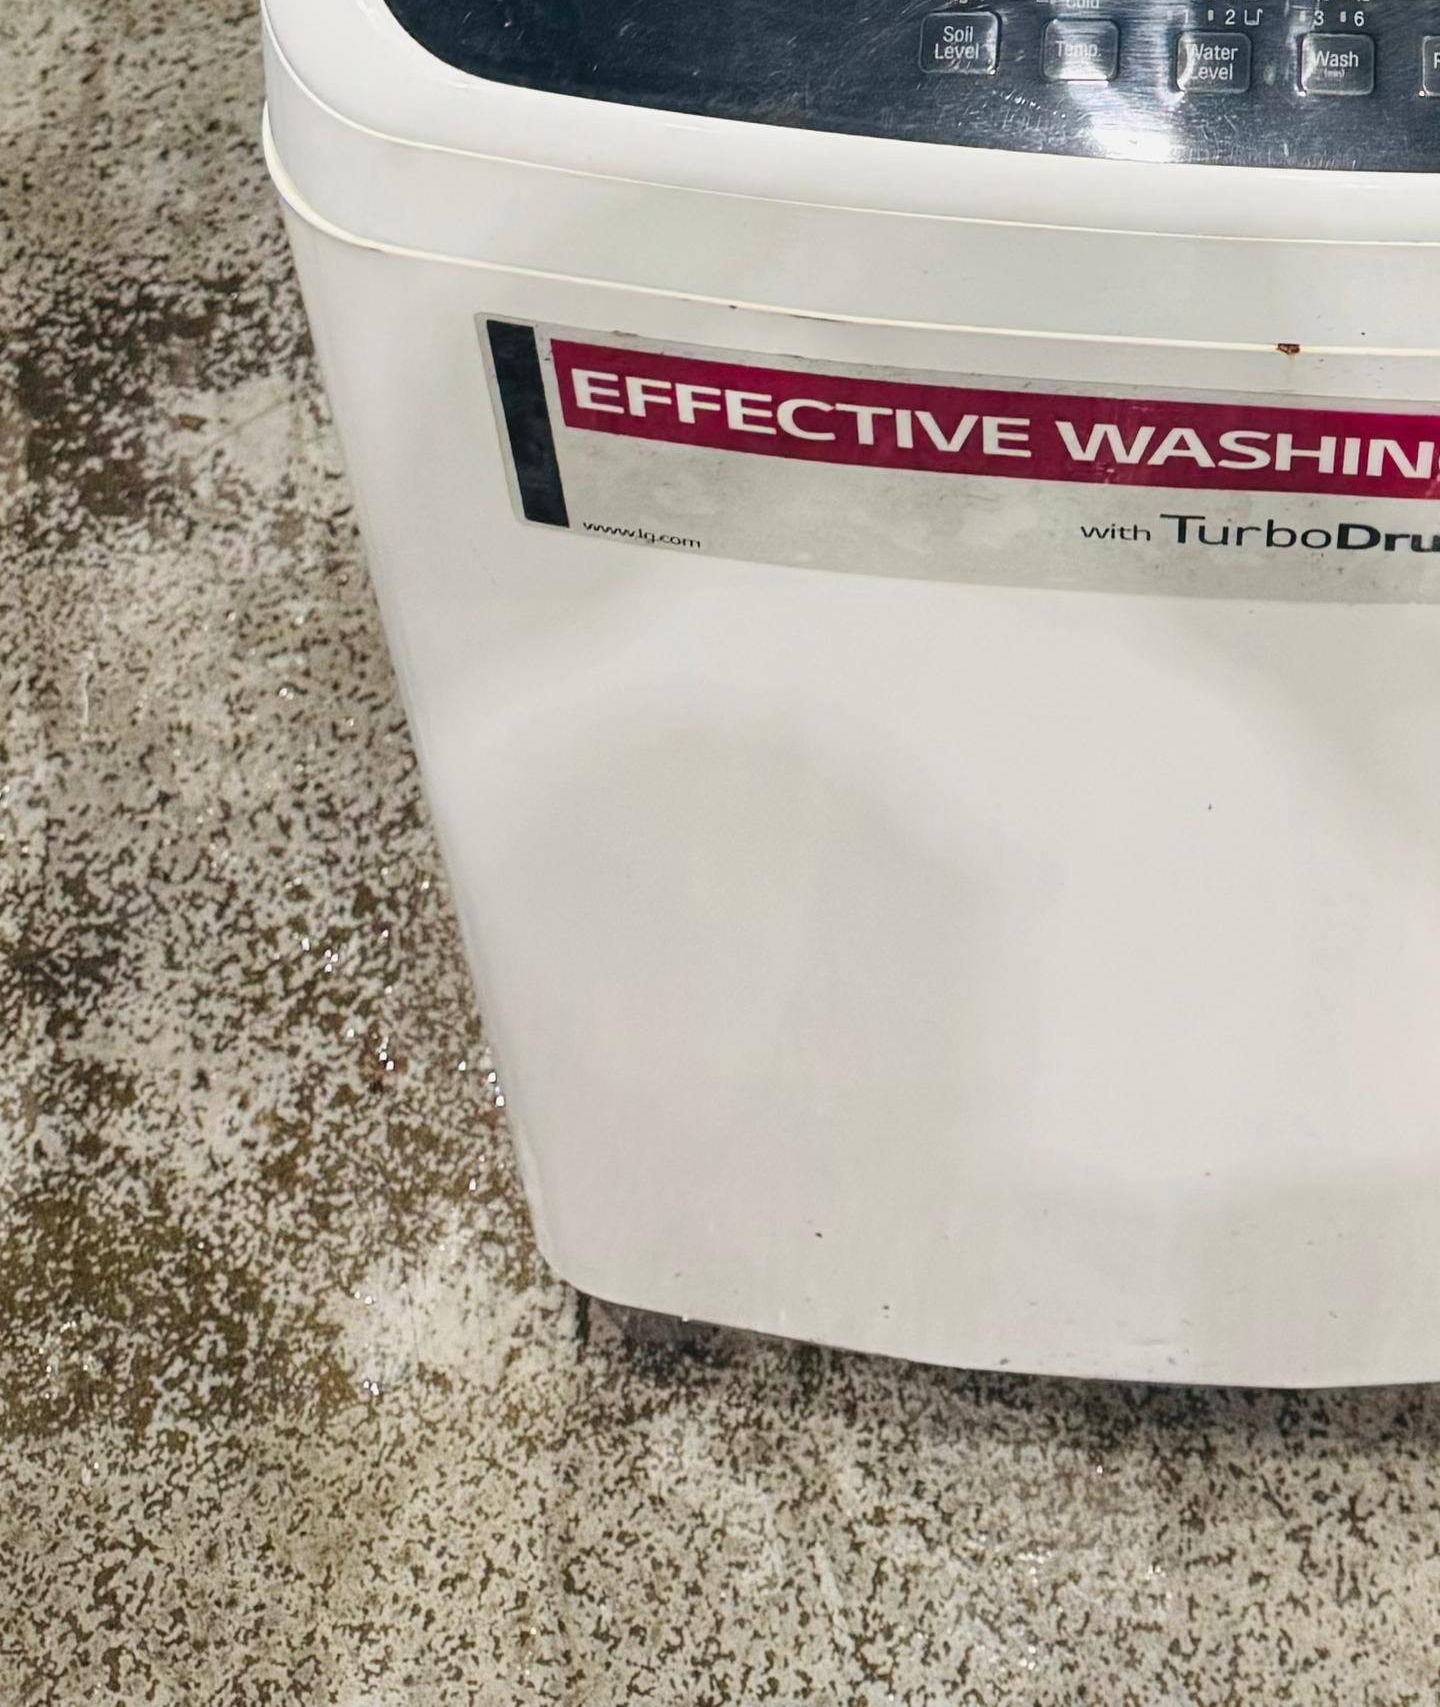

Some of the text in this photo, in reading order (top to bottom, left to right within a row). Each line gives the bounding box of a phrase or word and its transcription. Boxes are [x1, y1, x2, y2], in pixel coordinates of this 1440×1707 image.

[1225, 11, 1236, 25] 2
[1314, 11, 1364, 26] 3 6
[943, 26, 973, 43] Soil
[934, 44, 979, 60] Level
[1313, 50, 1359, 68] Wash
[571, 368, 1033, 459] EFFECTIVE
[582, 520, 702, 549] www.lg.com
[1080, 523, 1151, 542] with
